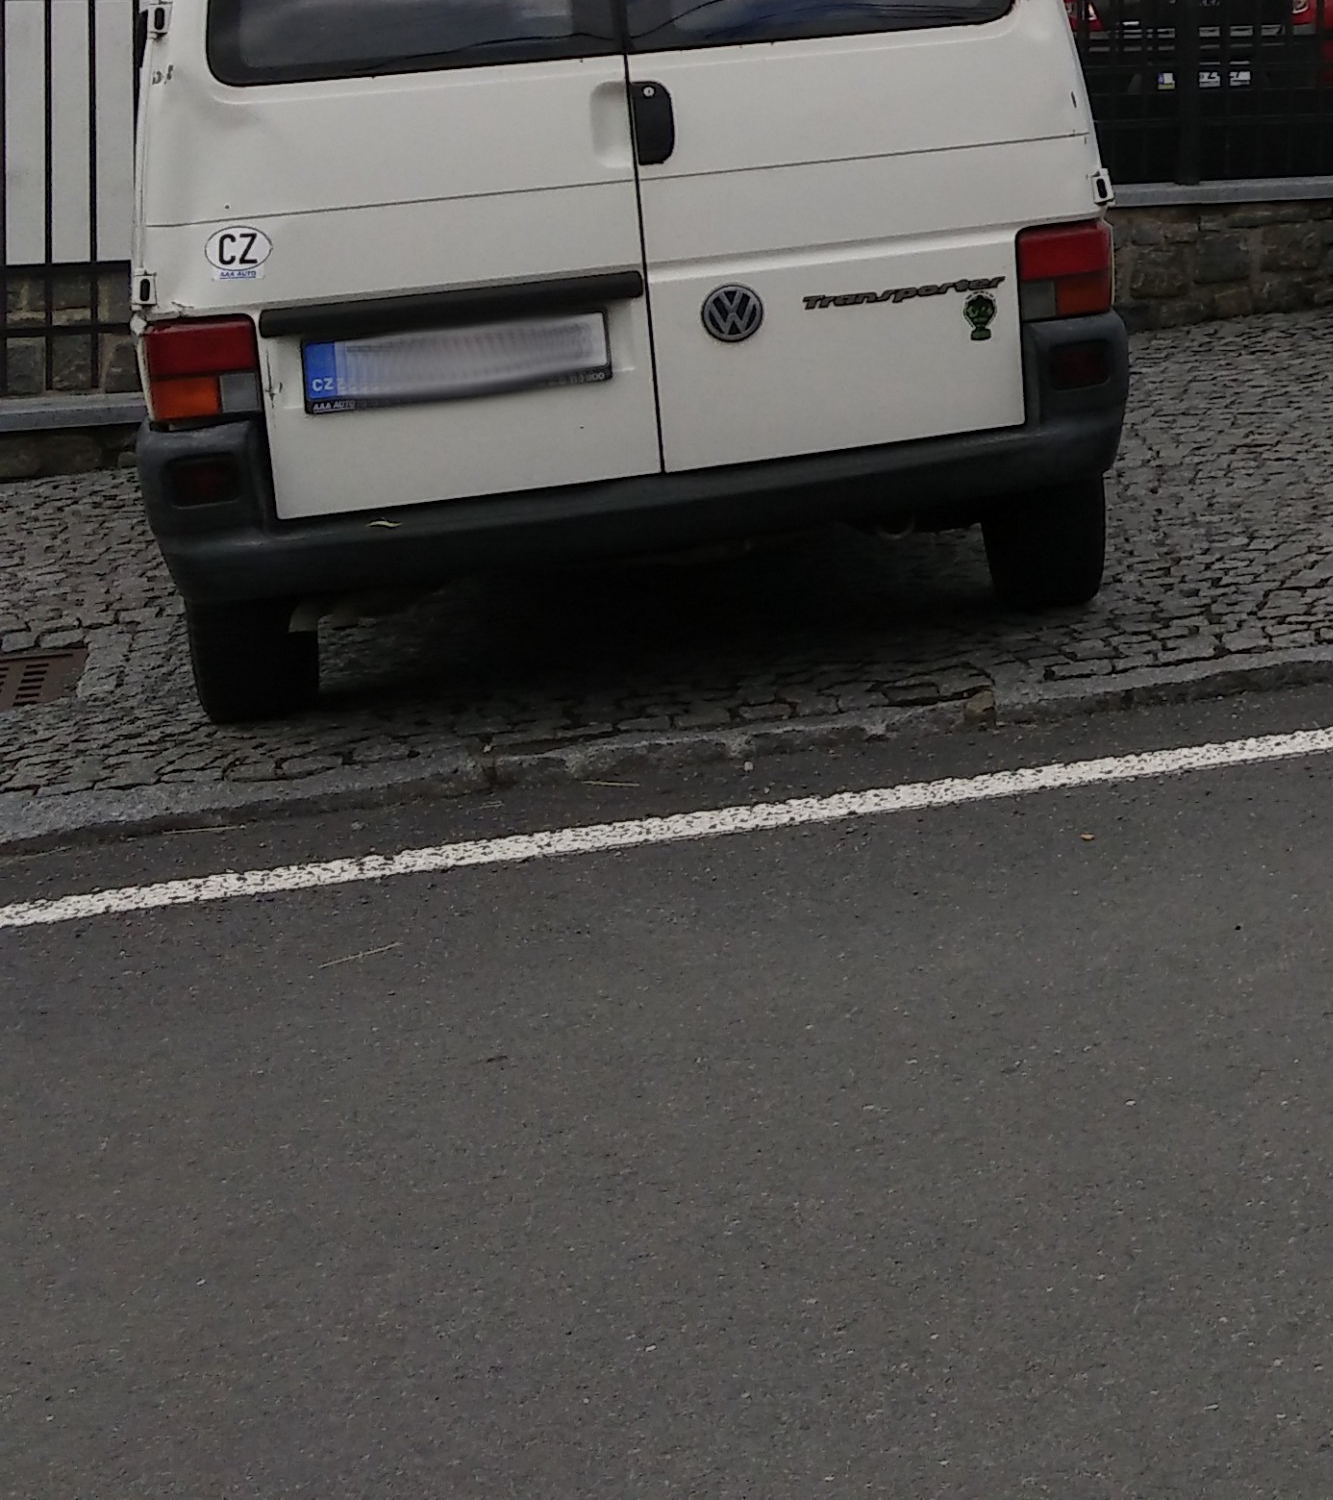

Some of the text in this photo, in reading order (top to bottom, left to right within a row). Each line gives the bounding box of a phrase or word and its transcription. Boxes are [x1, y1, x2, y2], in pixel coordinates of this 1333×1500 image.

[218, 232, 258, 265] CZ
[803, 276, 1006, 310] Transporter
[312, 377, 334, 391] CZ
